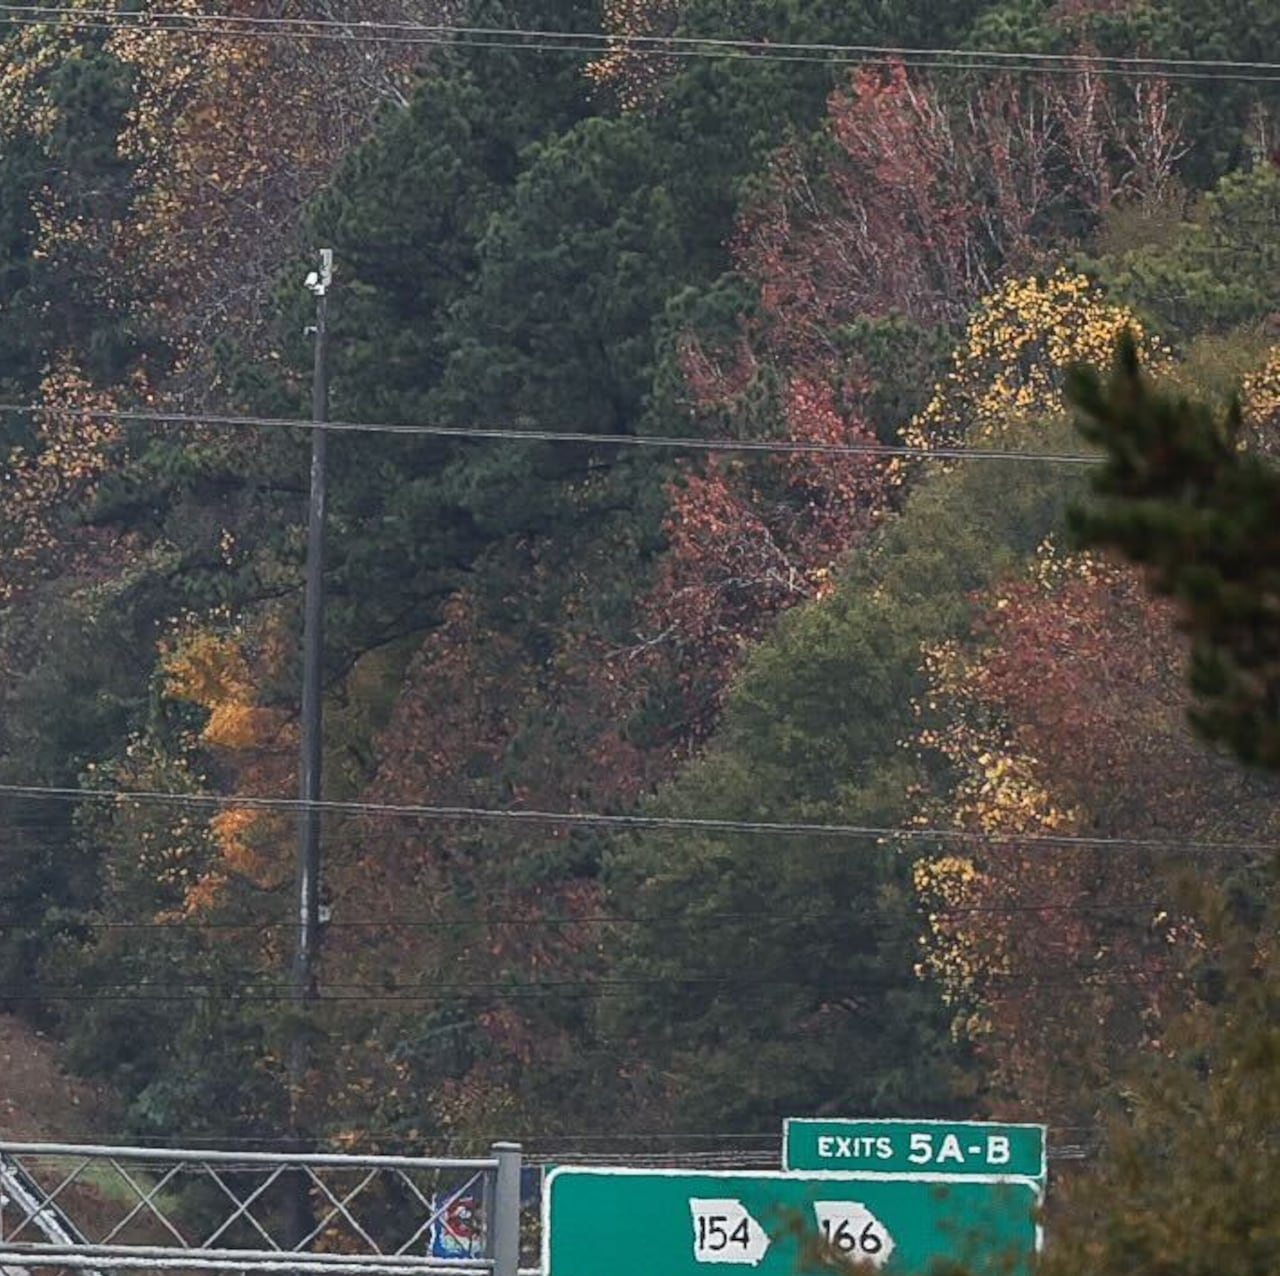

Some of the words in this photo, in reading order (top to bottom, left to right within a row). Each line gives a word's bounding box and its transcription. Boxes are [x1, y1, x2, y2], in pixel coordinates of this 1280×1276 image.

[817, 1135, 894, 1160] EXITS
[907, 1133, 1011, 1165] 5A-B
[698, 1216, 751, 1251] 154
[822, 1219, 883, 1255] 166
